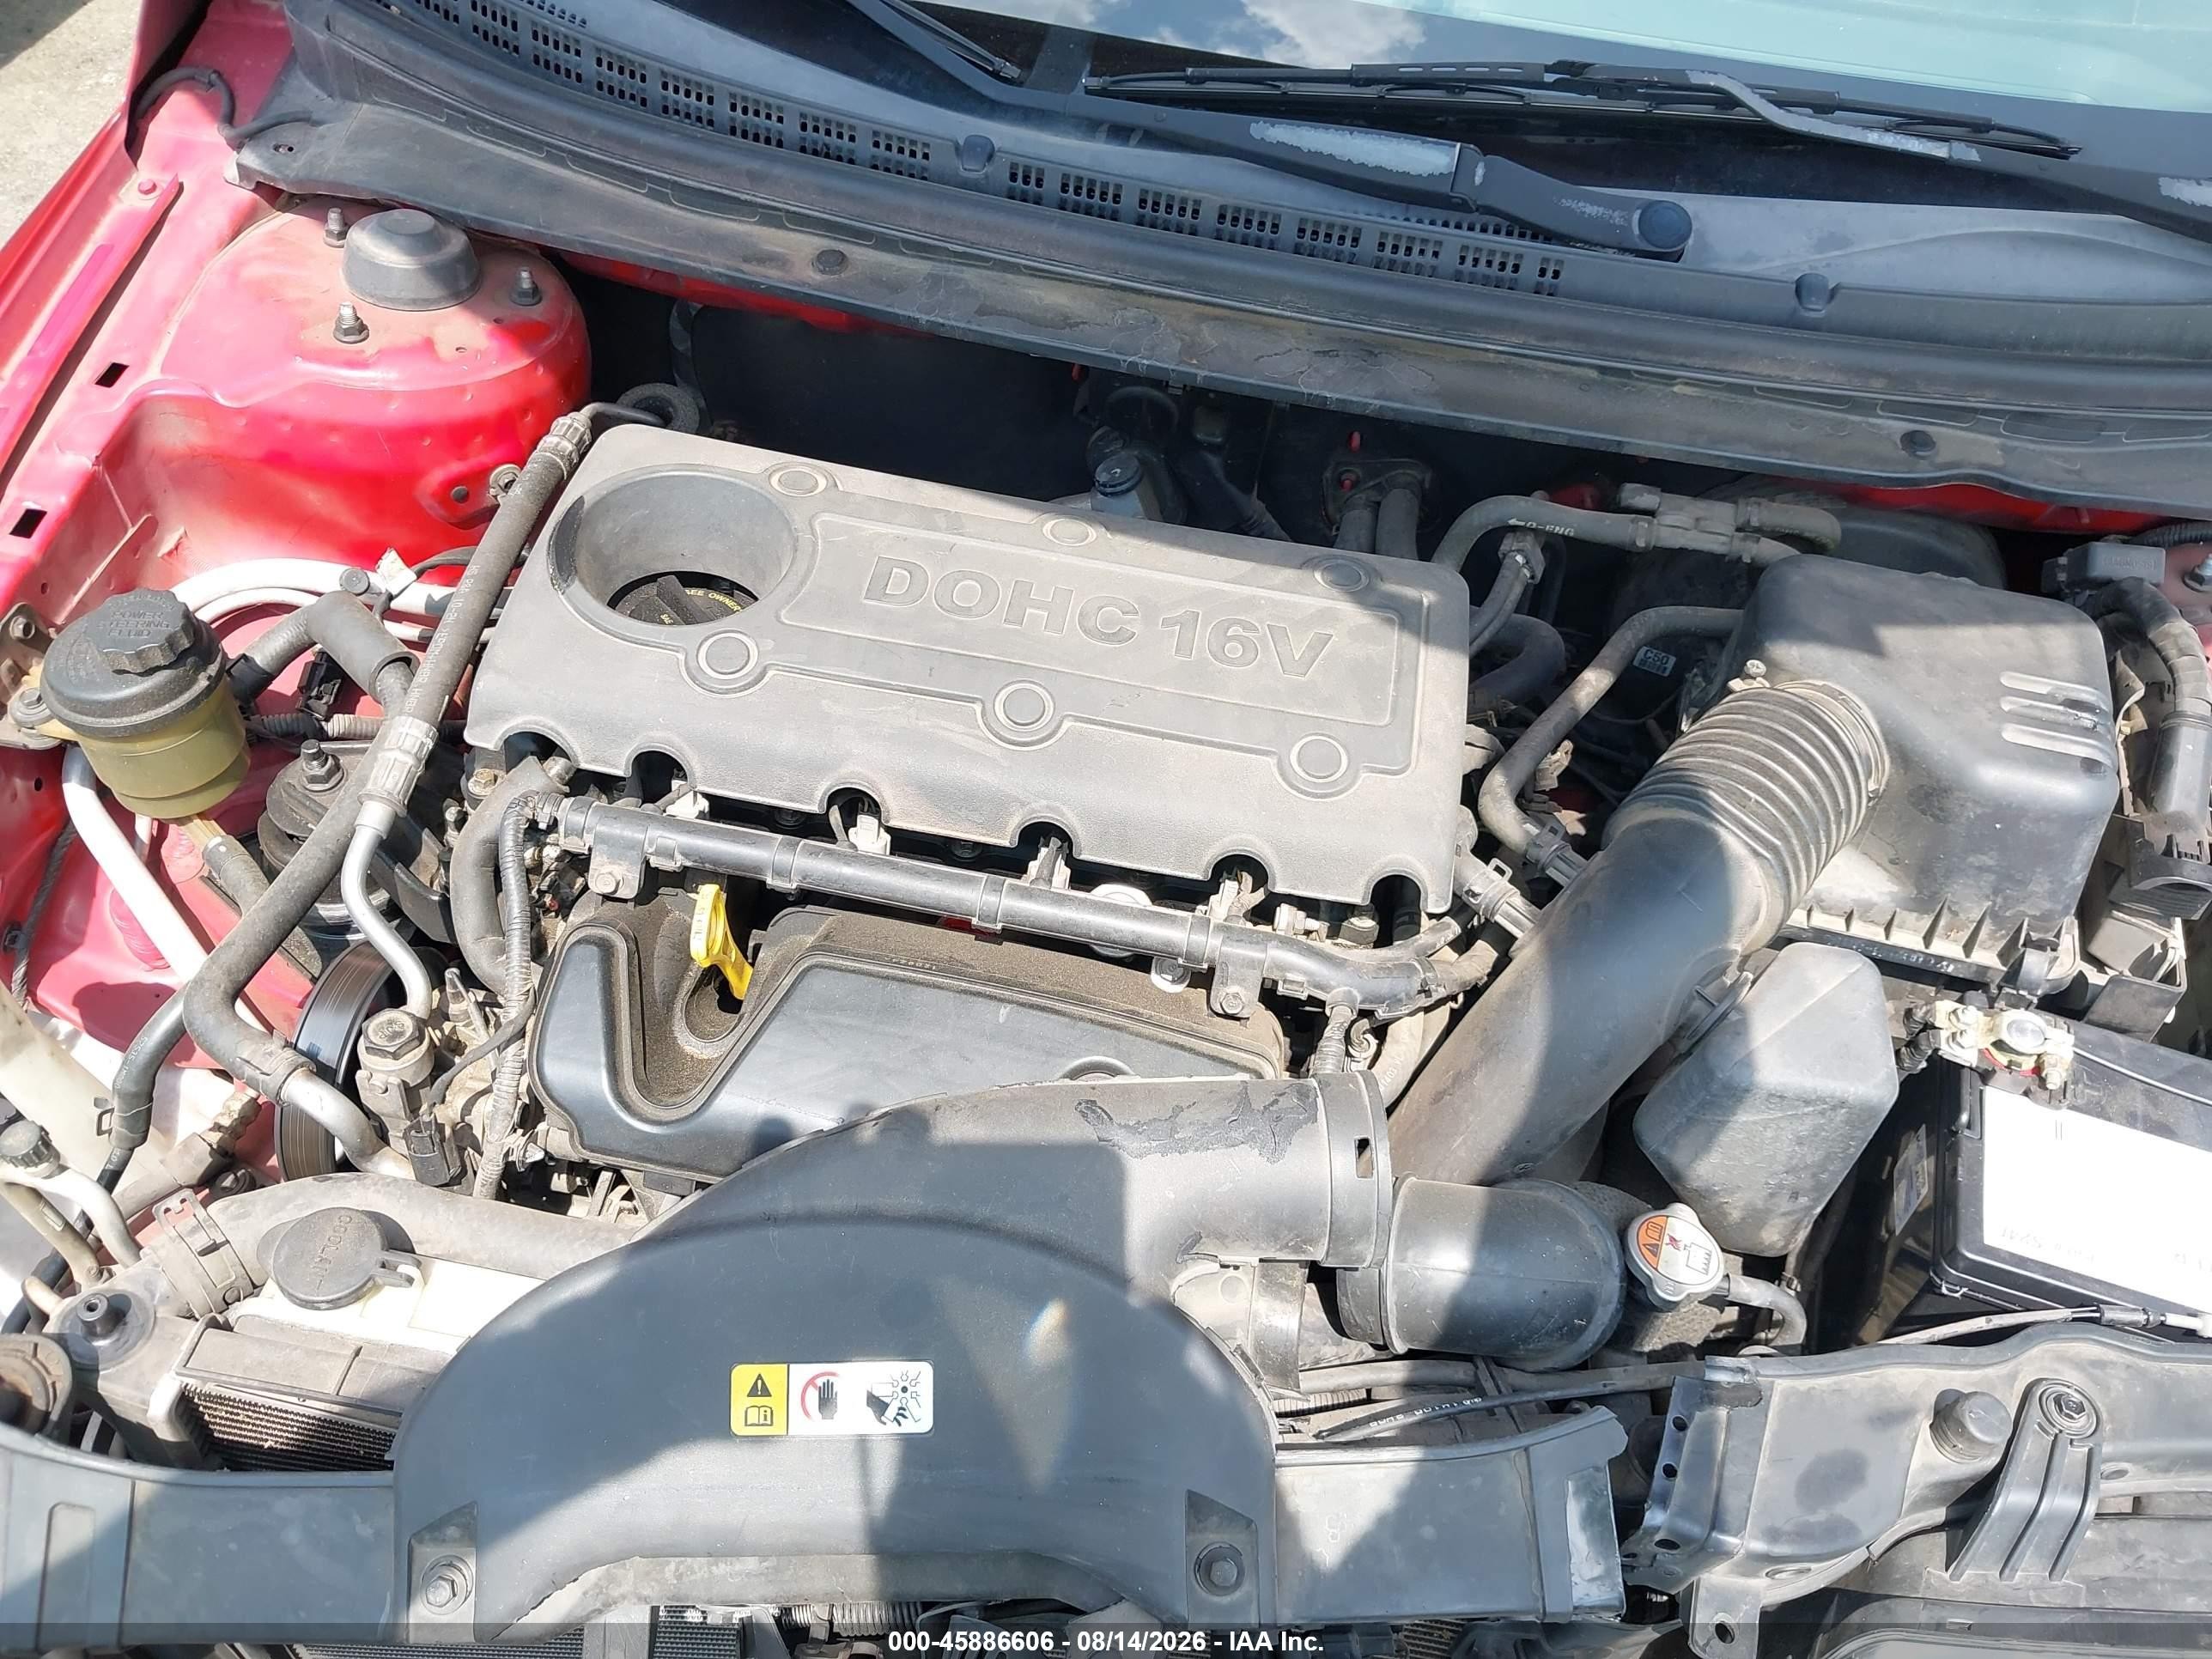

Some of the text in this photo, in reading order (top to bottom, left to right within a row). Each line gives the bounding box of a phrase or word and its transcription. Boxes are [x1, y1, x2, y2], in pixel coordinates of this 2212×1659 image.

[708, 592, 743, 611] OWNER
[111, 611, 165, 620] POWER
[864, 556, 1334, 678] DOHC 16V
[96, 619, 171, 630] STEERING
[108, 629, 151, 638] FLUID
[1644, 649, 1670, 666] C50
